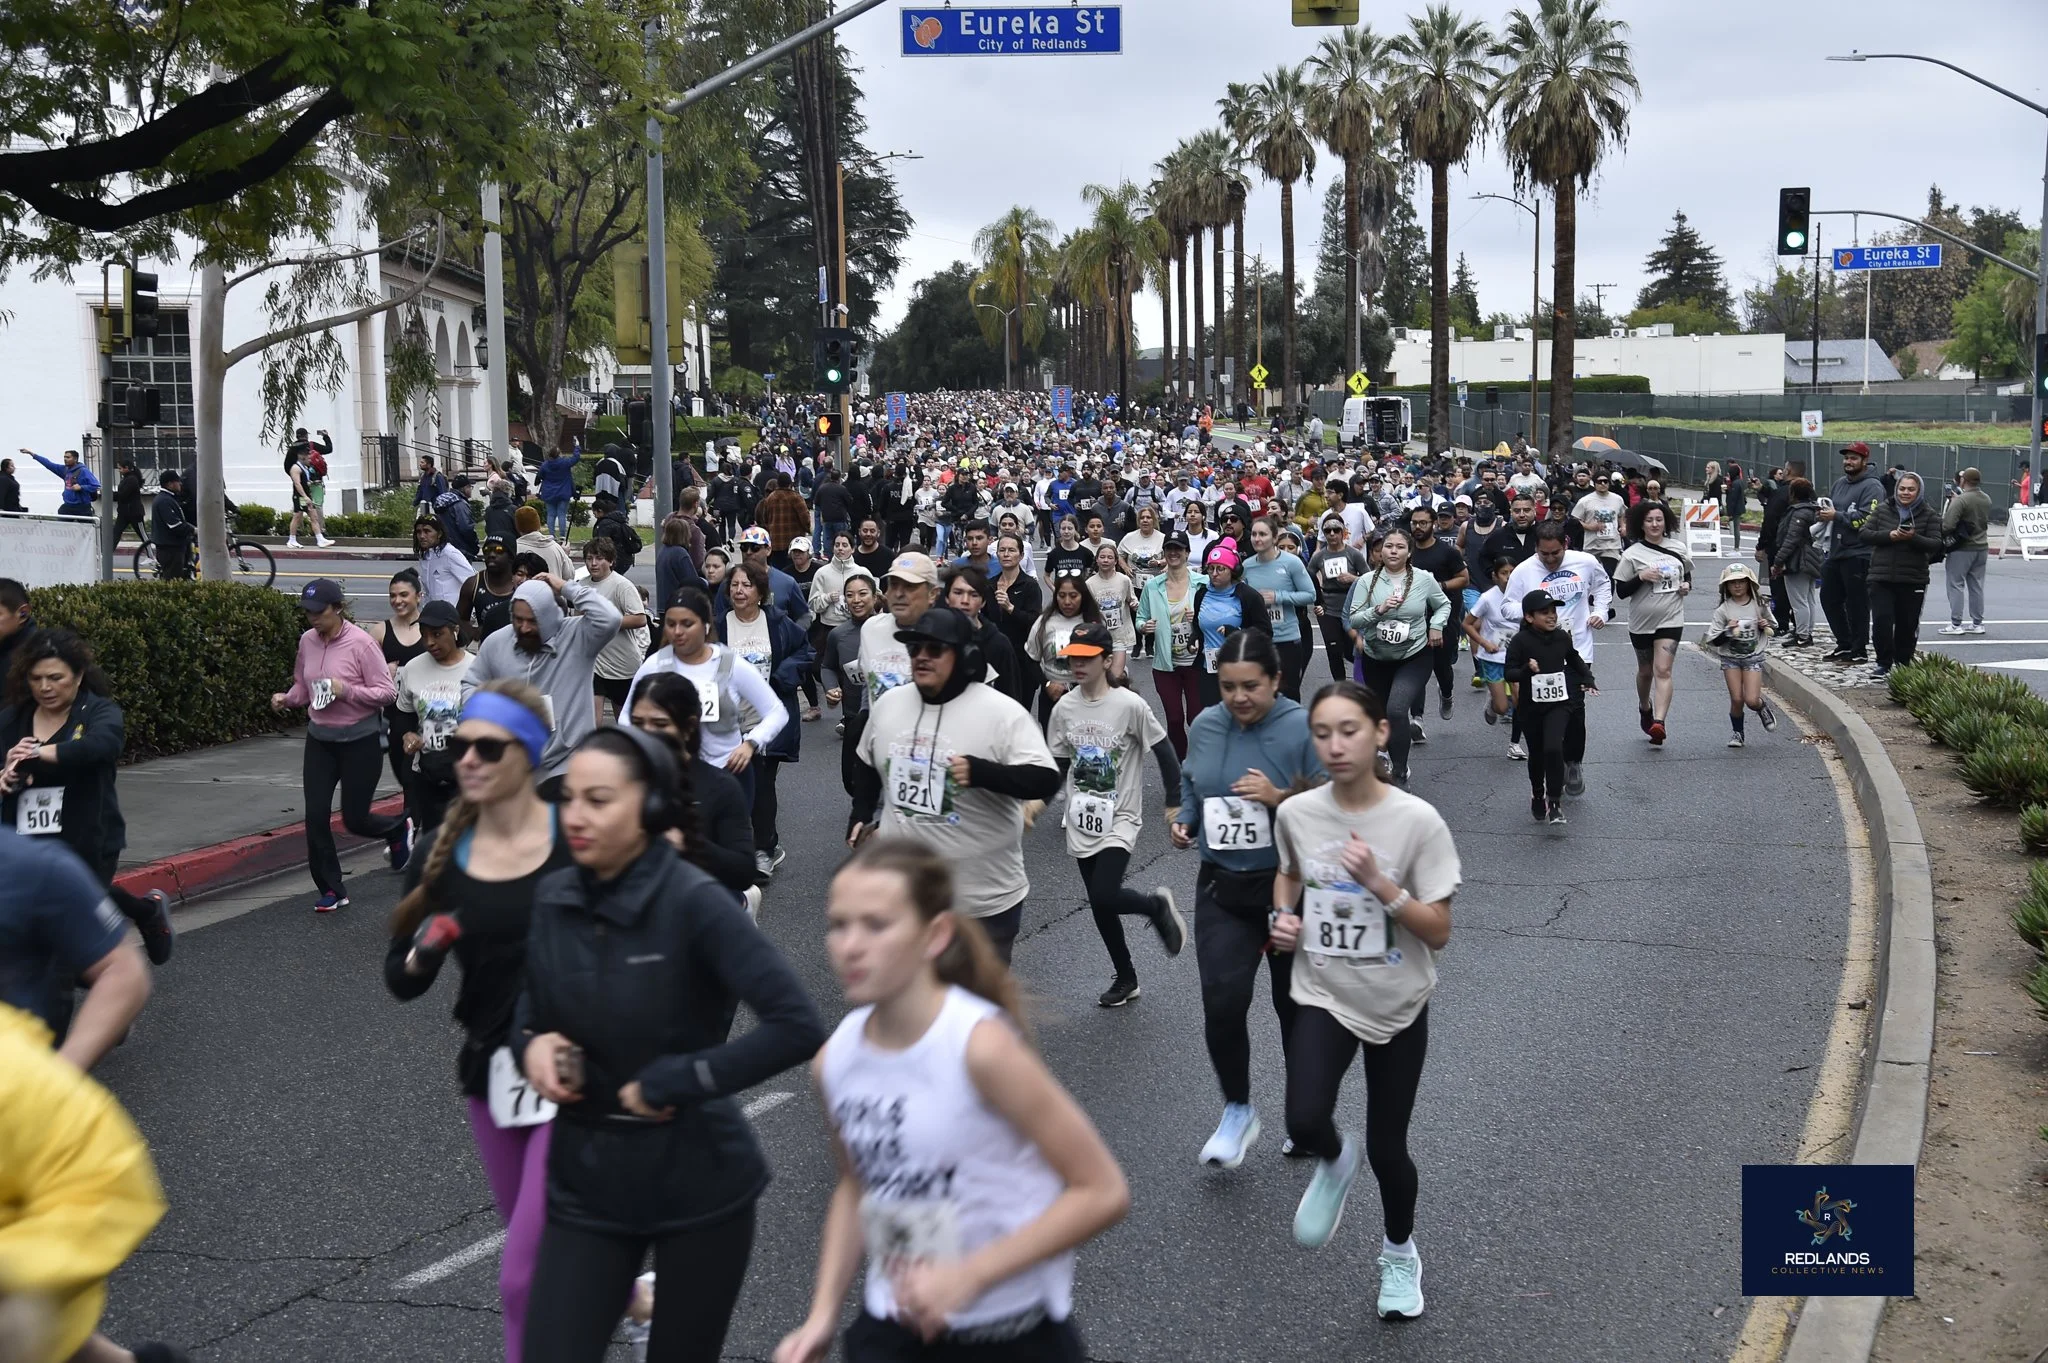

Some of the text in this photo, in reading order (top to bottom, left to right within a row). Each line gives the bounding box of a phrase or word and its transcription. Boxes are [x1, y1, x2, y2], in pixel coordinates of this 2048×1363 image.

[960, 9, 1104, 35] Eureka St
[978, 38, 1087, 52] City of Redlands
[1864, 246, 1931, 261] Eureka St
[1893, 259, 1925, 267] Redlands
[2021, 511, 2048, 521] ROAD
[2018, 524, 2048, 534] CLOS
[1172, 633, 1191, 644] 785
[1381, 629, 1402, 643] 930
[1536, 686, 1565, 700] 1395
[429, 735, 448, 749] 15
[1067, 732, 1120, 748] REDLANDS
[898, 782, 929, 808] 821
[27, 809, 63, 829] 504
[1078, 813, 1103, 833] 188
[1218, 823, 1257, 844] 275
[1320, 921, 1367, 950] 817
